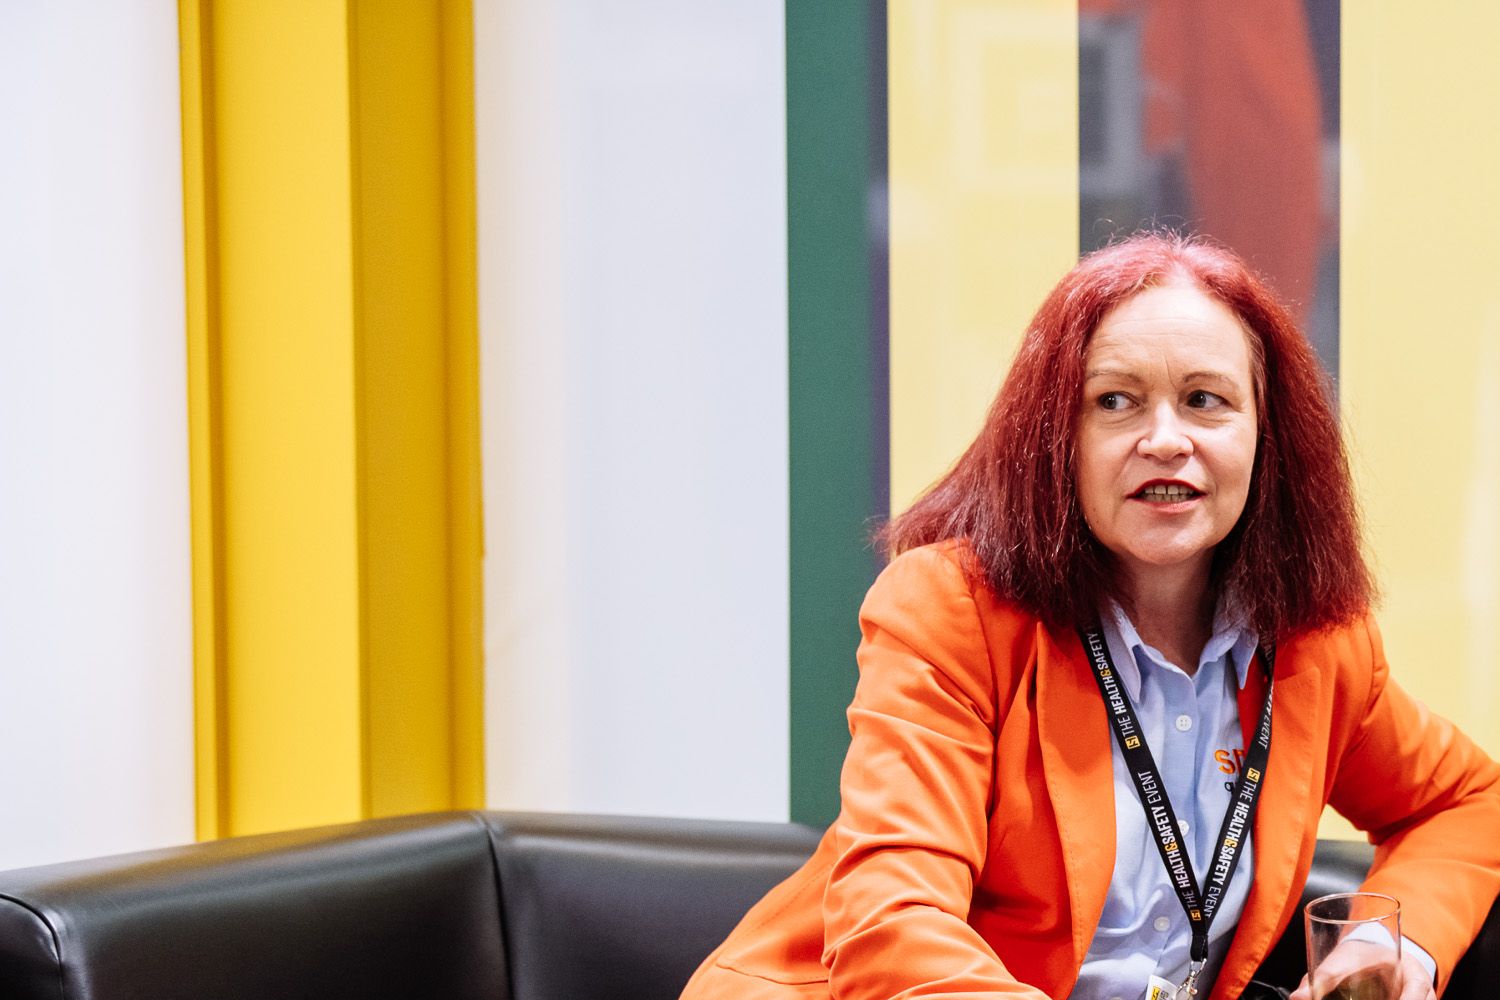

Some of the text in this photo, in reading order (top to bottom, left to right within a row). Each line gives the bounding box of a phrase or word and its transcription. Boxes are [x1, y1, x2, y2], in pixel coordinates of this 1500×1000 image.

[1088, 633, 1135, 736] THE HEALTH&SAFETY
[1258, 714, 1273, 750] EVENT
[1137, 770, 1198, 909] THE HEALTH&SAFETY EVENT
[1204, 782, 1257, 919] THE HEALTH&SAFETY EVENT
